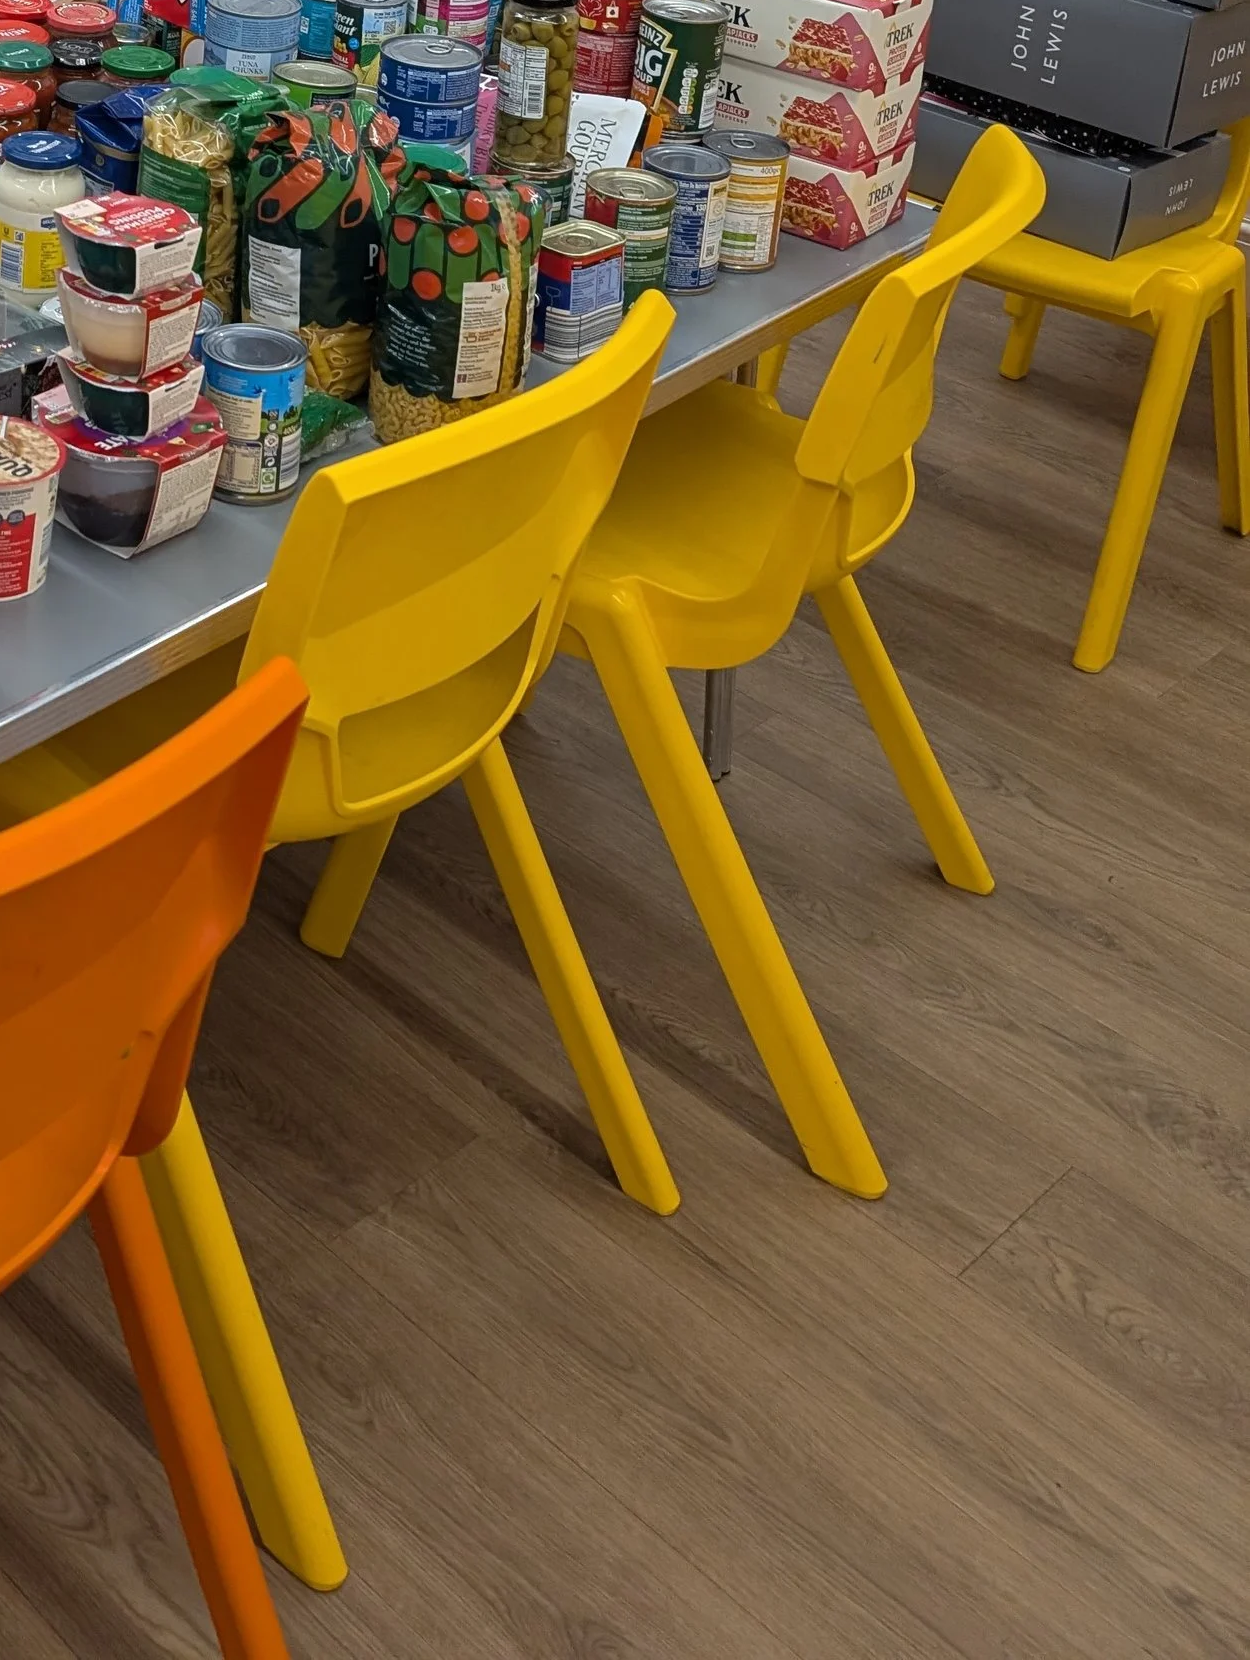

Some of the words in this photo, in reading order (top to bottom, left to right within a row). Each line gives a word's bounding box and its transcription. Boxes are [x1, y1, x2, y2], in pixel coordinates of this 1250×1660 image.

[726, 2, 754, 29] EK
[727, 30, 757, 43] APJACKS
[884, 22, 915, 50] TREK
[1010, 4, 1036, 71] JOHN
[1040, 8, 1068, 85] LEWIS
[237, 60, 259, 68] TUNA
[888, 45, 908, 56] PROTEIN
[1210, 40, 1246, 68] JOHN
[232, 66, 265, 76] CHUNKS
[1202, 70, 1242, 98] LEWIS
[718, 79, 744, 106] EK
[717, 102, 748, 118] APJACKS
[874, 99, 904, 127] TREK
[879, 122, 898, 134] PROTEIN
[867, 181, 895, 208] TREK
[1168, 177, 1196, 197] LEWIS
[1164, 198, 1188, 216] JOHN
